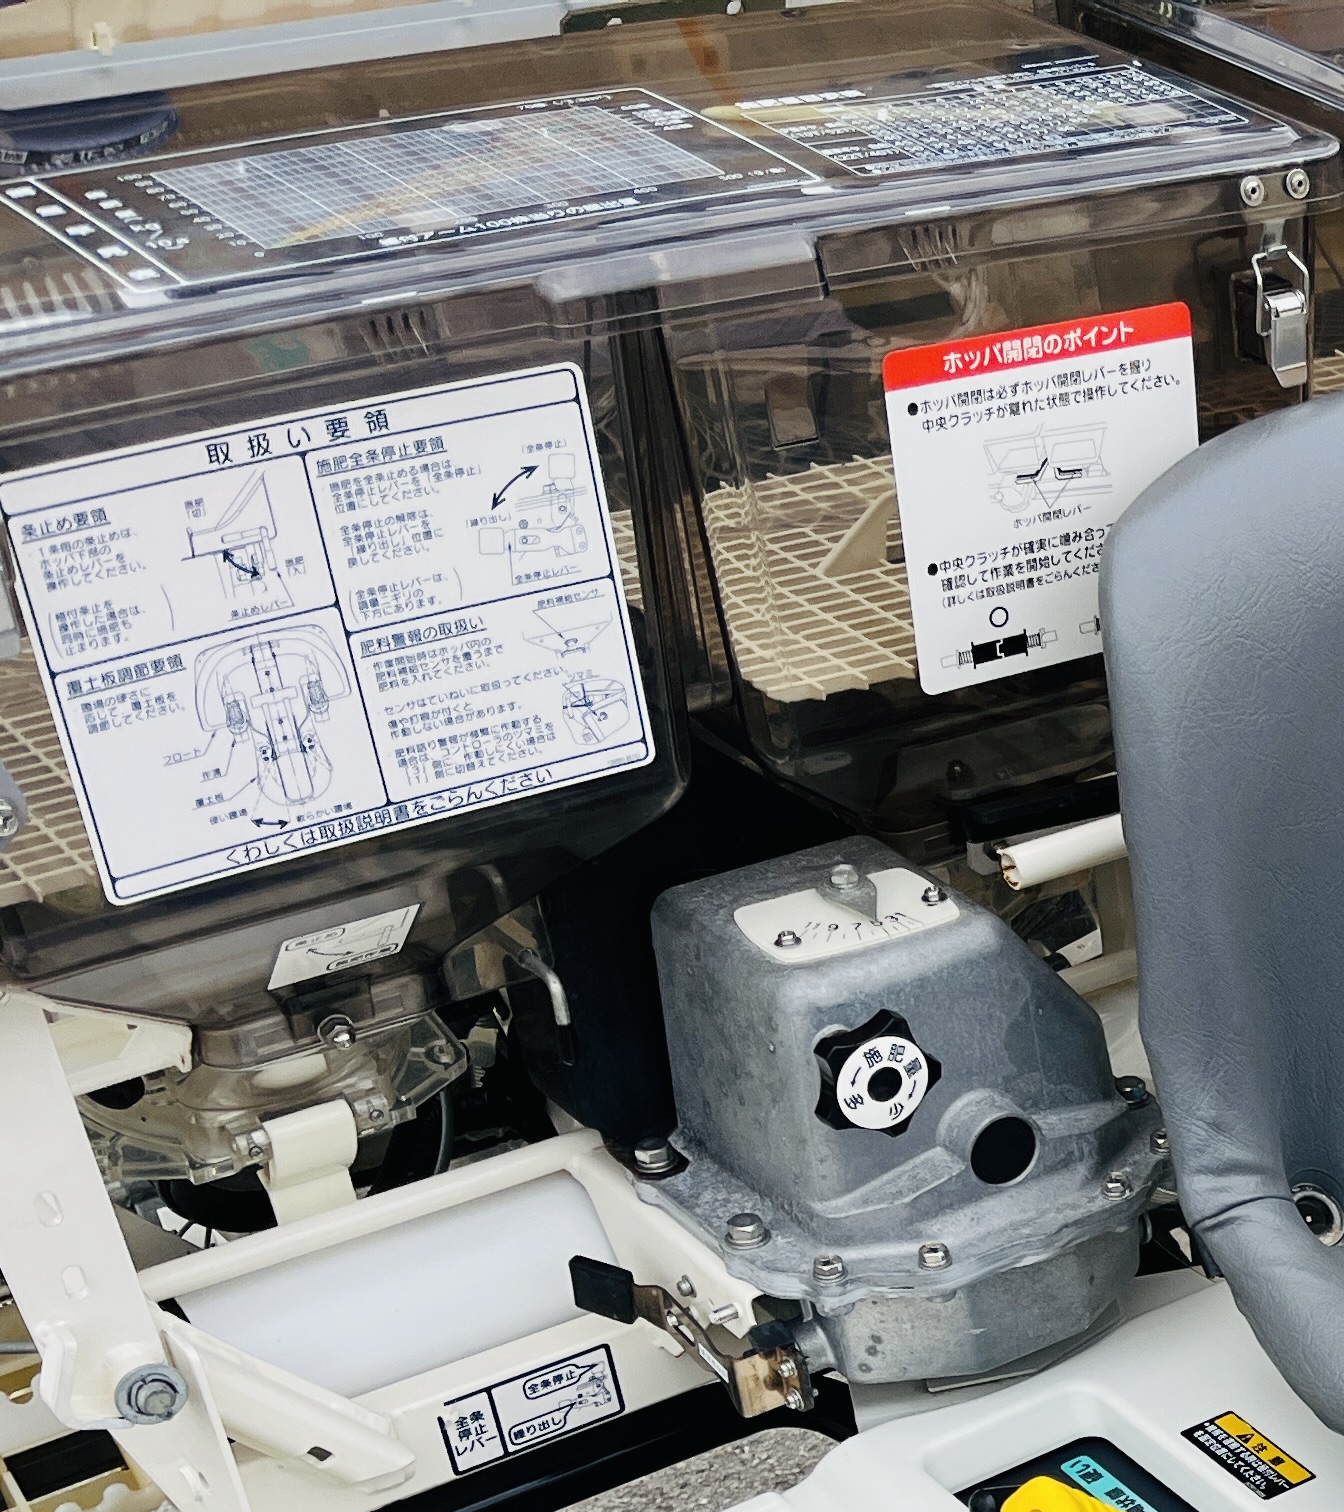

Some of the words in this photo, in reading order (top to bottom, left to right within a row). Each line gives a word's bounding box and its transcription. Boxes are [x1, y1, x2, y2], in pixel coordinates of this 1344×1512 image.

[941, 316, 1135, 376] ホッパ開閉のポイント
[206, 408, 391, 466] 取扱い要領
[314, 434, 446, 476] 施肥全条停止要領
[1012, 500, 1091, 531] ホッパ開閉レバー
[357, 612, 485, 657] 肥料警報の取扱い
[161, 745, 203, 765] フロート
[225, 768, 552, 866] くわしくは取扱説明書をごらんください
[526, 1368, 577, 1396] 全条停止
[453, 1408, 485, 1430] 全条
[456, 1421, 489, 1443] 停止
[453, 1430, 498, 1457] レバー
